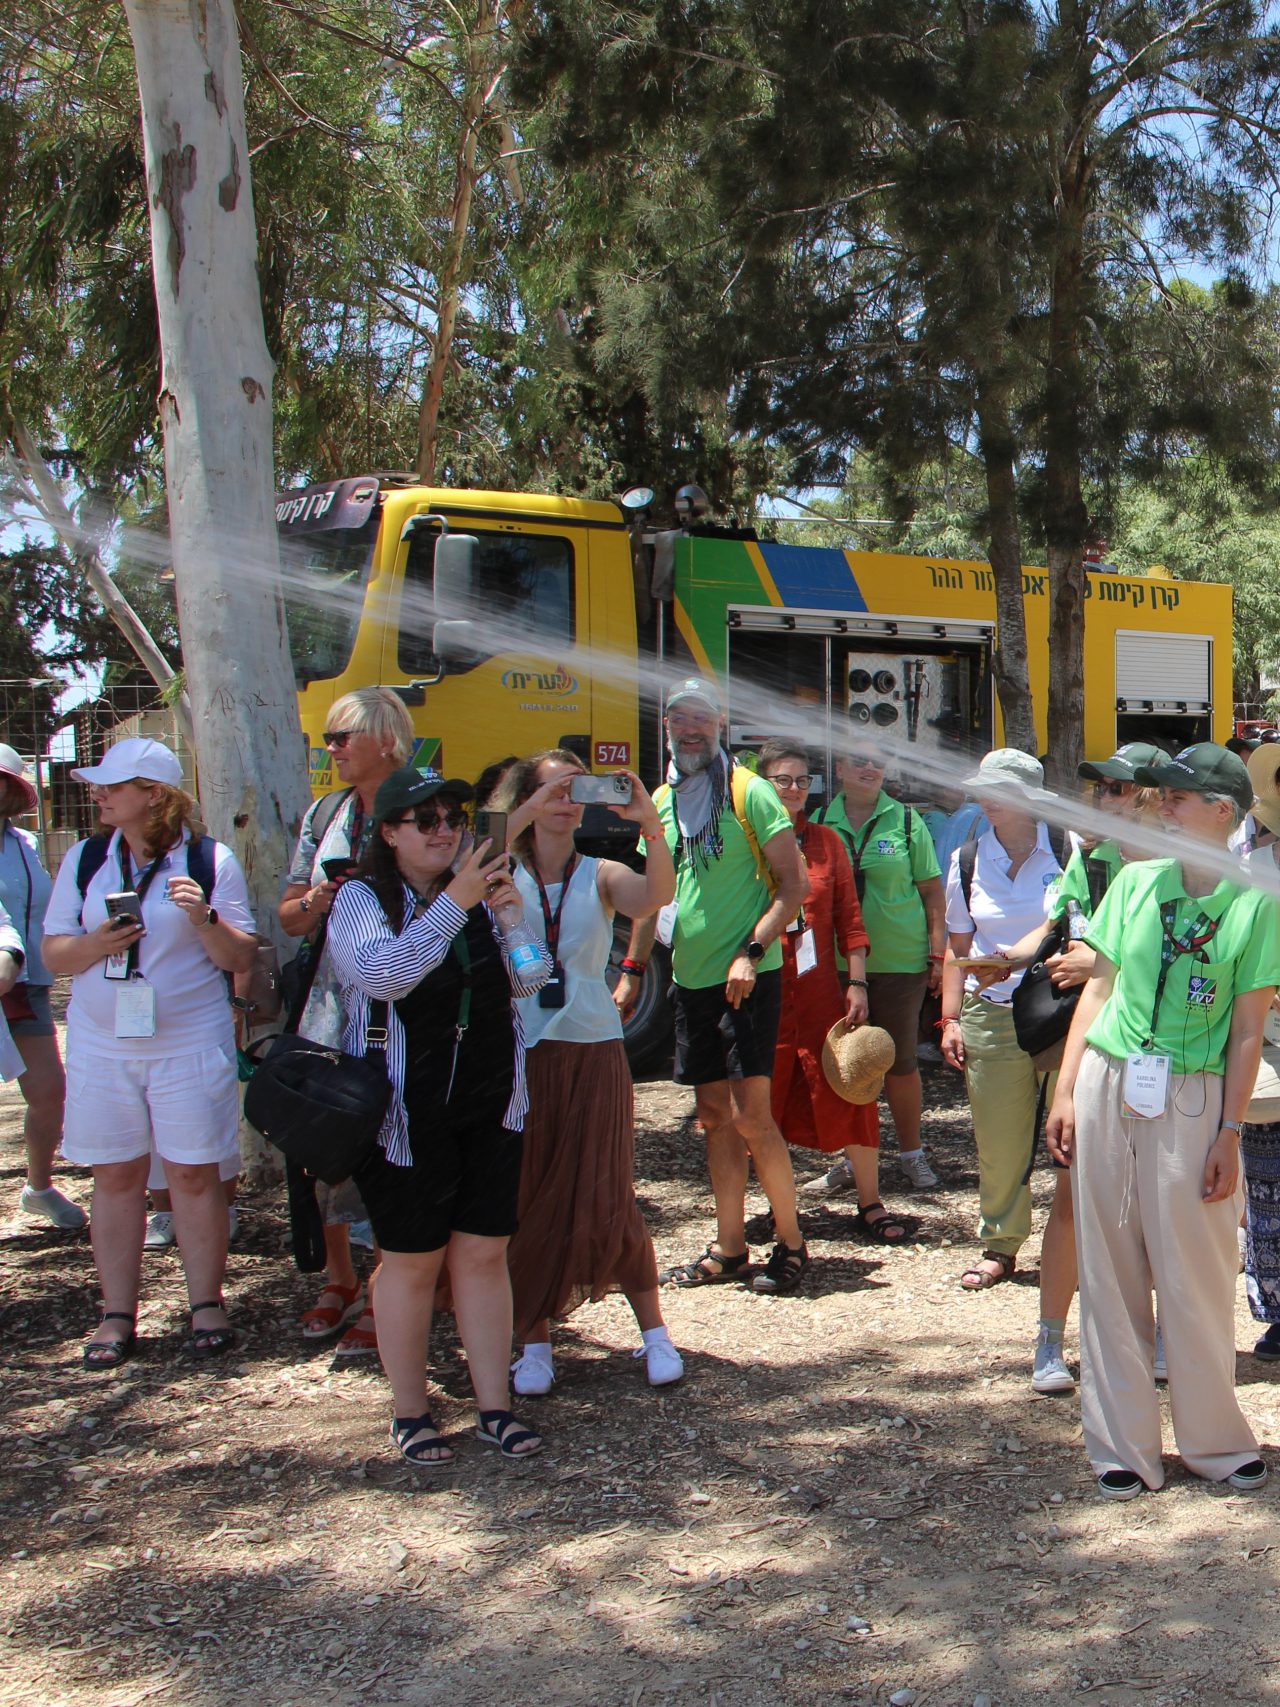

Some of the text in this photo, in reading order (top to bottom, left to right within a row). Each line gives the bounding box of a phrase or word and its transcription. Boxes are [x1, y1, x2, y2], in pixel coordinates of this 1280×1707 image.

[303, 491, 336, 521] קרן
[926, 566, 963, 589] ההר
[969, 570, 997, 591] זור
[1099, 581, 1145, 608] קימת
[1150, 586, 1180, 611] קרן
[598, 745, 628, 762] 574
